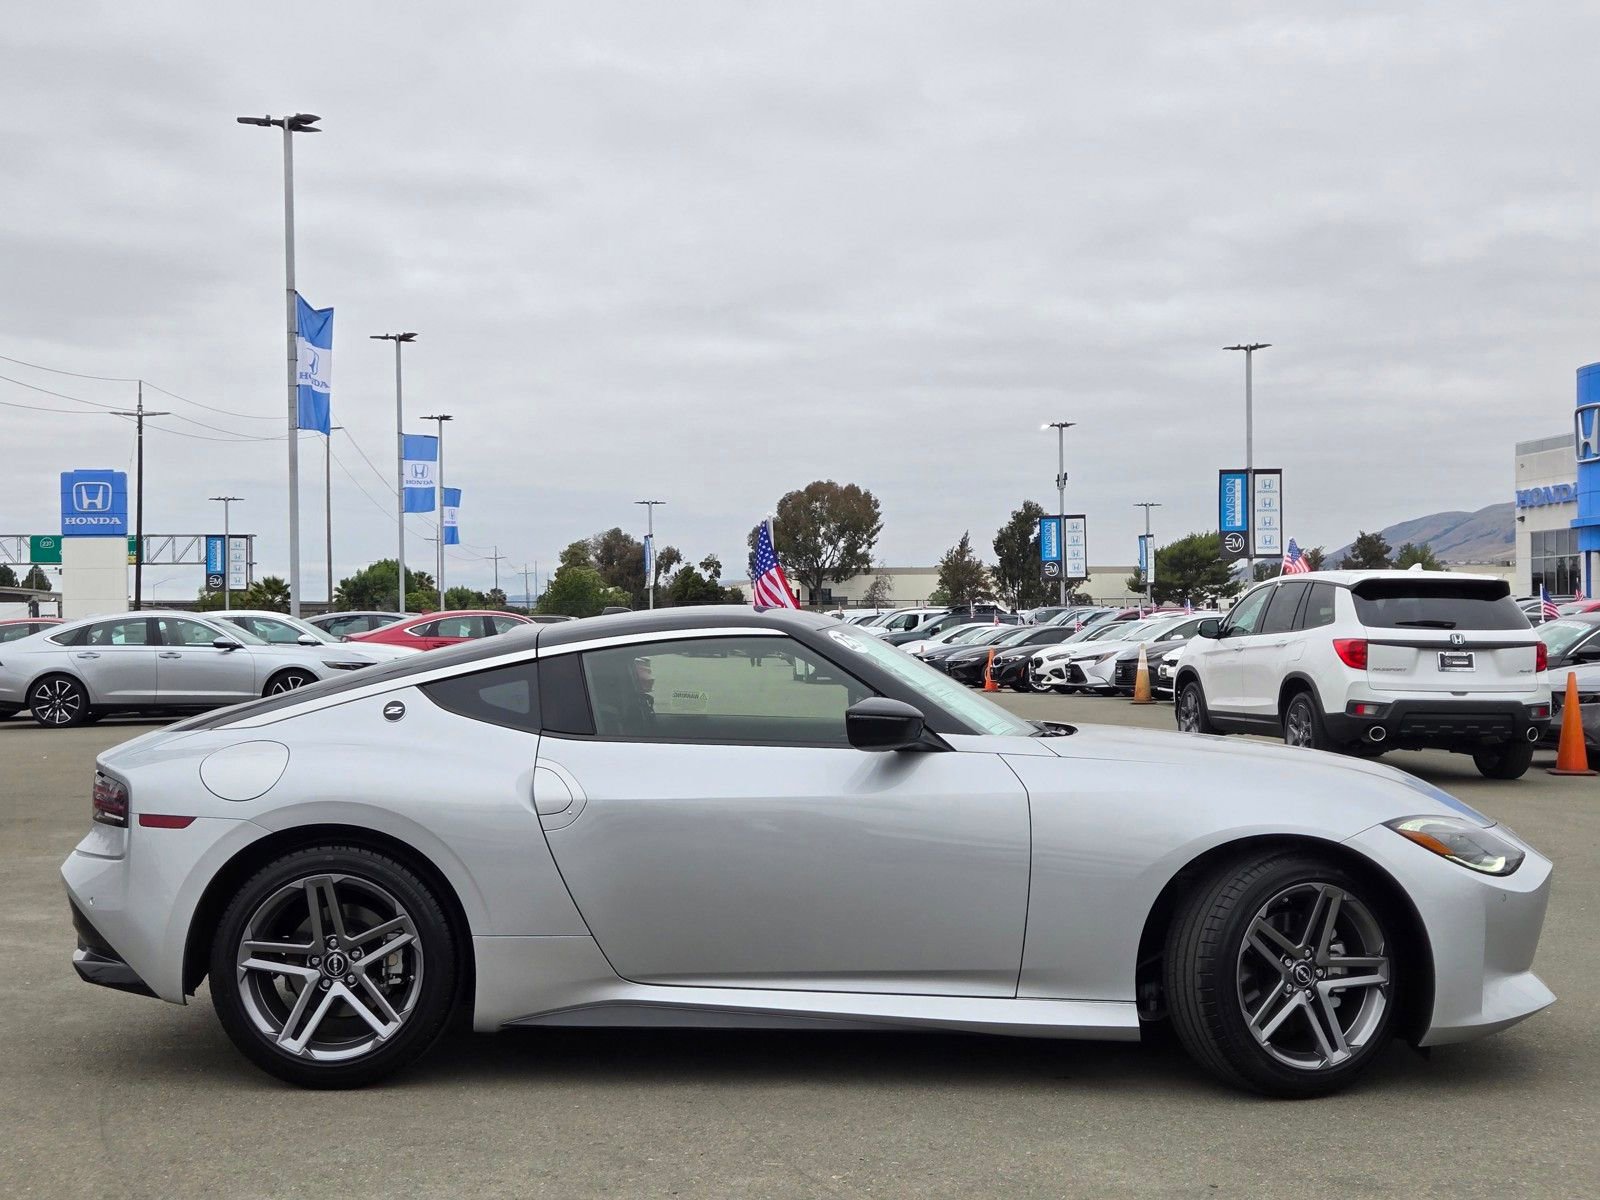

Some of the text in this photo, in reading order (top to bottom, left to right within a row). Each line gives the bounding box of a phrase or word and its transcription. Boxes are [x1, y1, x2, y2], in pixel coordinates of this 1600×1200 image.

[299, 372, 330, 388] HDA
[1225, 478, 1235, 527] ENVISION
[64, 517, 122, 525] HONDA
